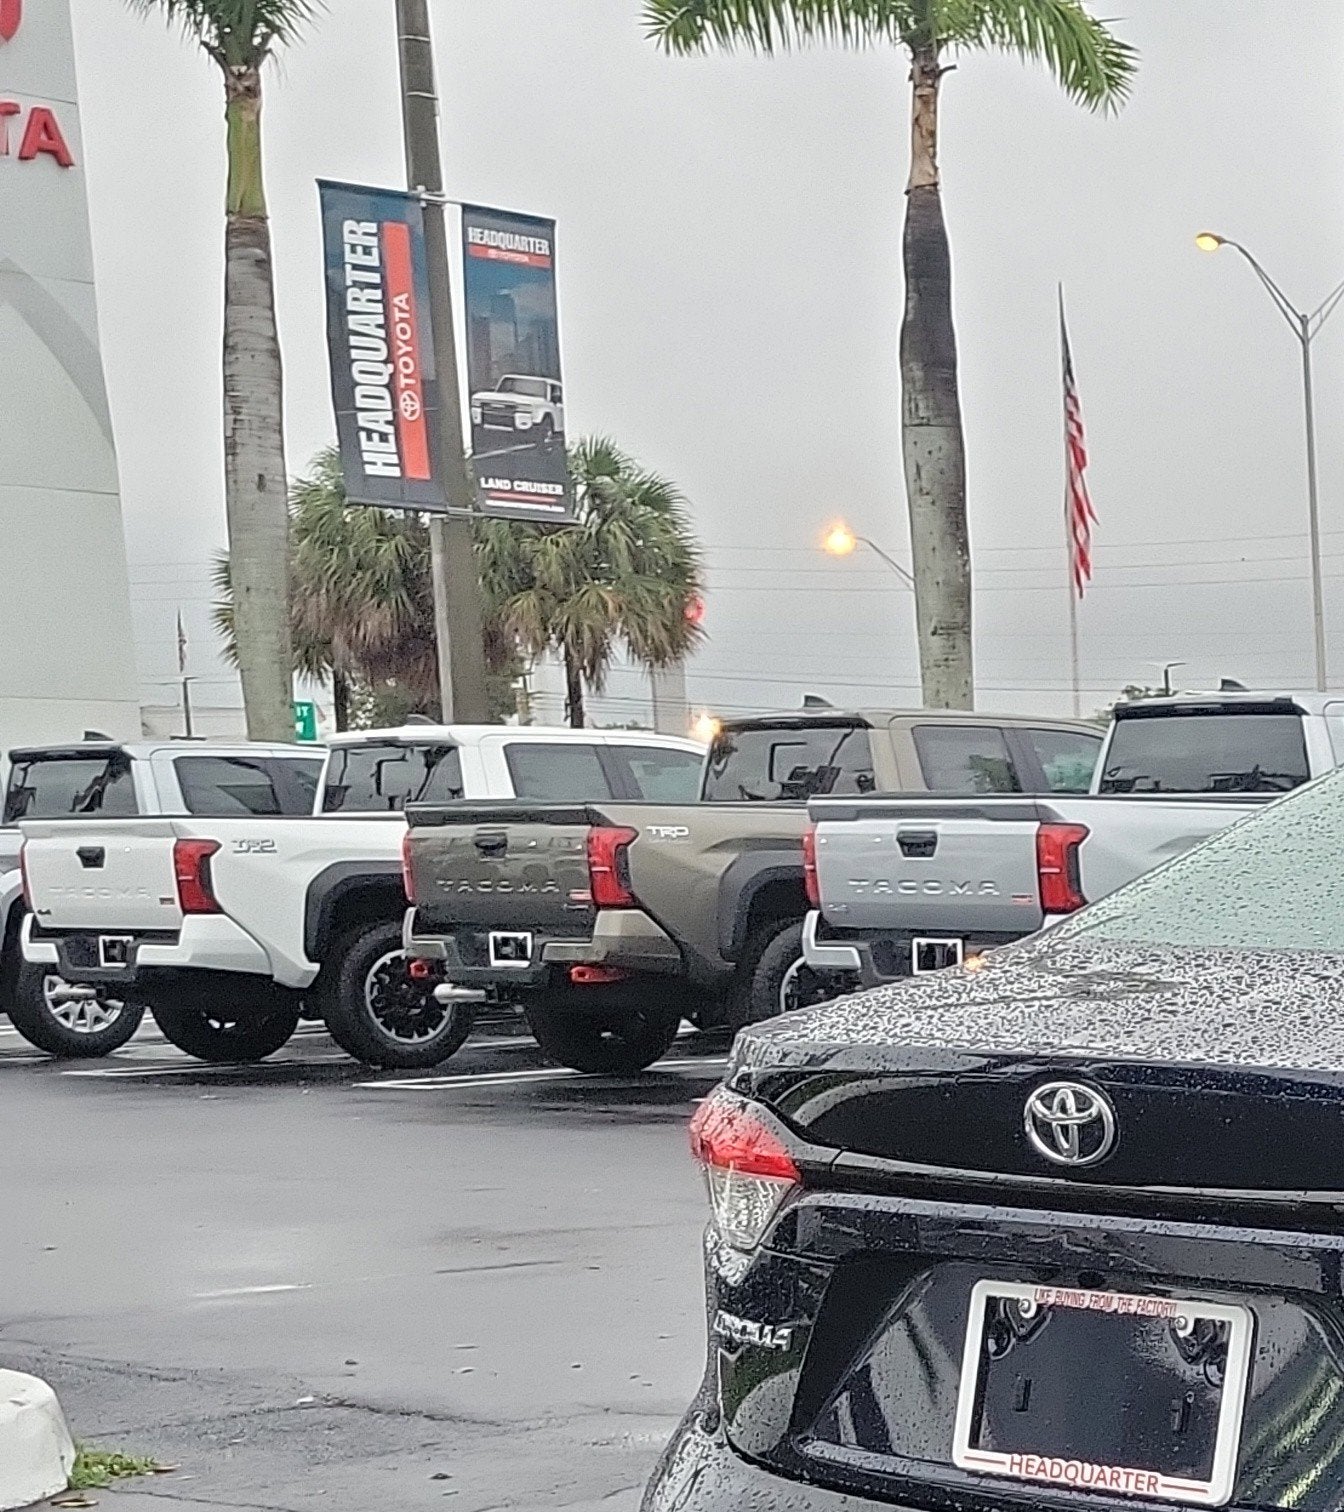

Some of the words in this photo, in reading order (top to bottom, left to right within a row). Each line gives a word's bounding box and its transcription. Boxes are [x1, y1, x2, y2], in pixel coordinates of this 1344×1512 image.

[468, 227, 550, 255] HEADQUARTER
[343, 220, 402, 478] HEADQUARTER
[393, 293, 417, 388] TOYOTA
[480, 477, 511, 490] LAND
[513, 480, 564, 495] CRUISER
[646, 826, 689, 838] TRD
[436, 879, 560, 893] TACOMA
[848, 878, 1000, 895] TACOMA
[1035, 1288, 1052, 1302] LIKE
[1055, 1290, 1086, 1308] BUYING
[1090, 1293, 1114, 1311] FROM
[1118, 1296, 1134, 1313] THE
[1010, 1455, 1159, 1493] HEADQUARTER
